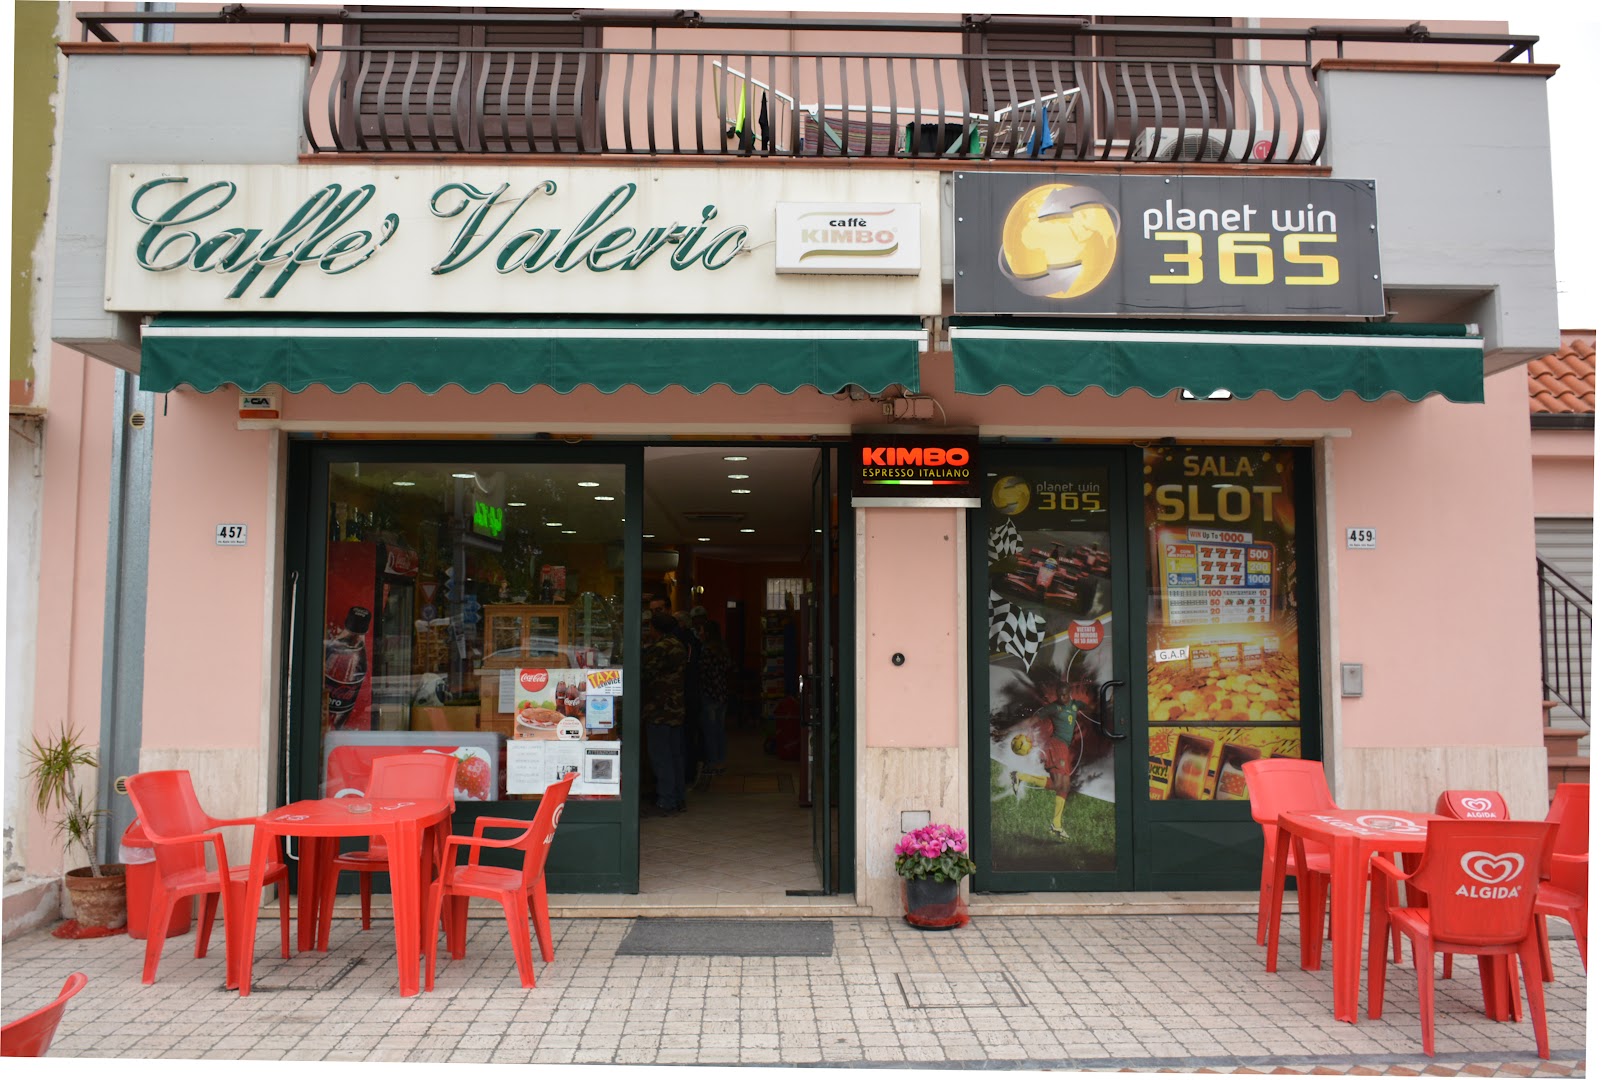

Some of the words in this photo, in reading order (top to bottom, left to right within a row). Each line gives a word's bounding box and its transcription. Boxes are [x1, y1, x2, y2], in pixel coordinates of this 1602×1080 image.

[829, 217, 868, 229] caffè
[1143, 199, 1257, 240] planet
[1271, 203, 1337, 233] win
[430, 180, 750, 275] Valerio
[800, 228, 895, 246] KIMBO
[1149, 232, 1341, 286] 365
[862, 447, 970, 467] KIMBO
[1183, 455, 1254, 478] SALA
[862, 468, 914, 478] ESPRESSO
[919, 468, 970, 478] ITALIANO
[1036, 481, 1074, 495] planet
[1078, 482, 1100, 492] win
[1038, 492, 1101, 511] 365
[1155, 483, 1283, 523] SLOT
[219, 526, 243, 539] 457
[1202, 532, 1210, 540] Up
[1219, 533, 1245, 543] 1000
[1350, 530, 1373, 542] 459
[1167, 544, 1177, 557] 2
[1200, 547, 1213, 559] 7
[1215, 547, 1228, 559] 7
[1230, 548, 1242, 560] 7
[1249, 549, 1269, 559] 500
[1201, 561, 1214, 572] 7
[1215, 561, 1228, 572] 7
[1230, 561, 1242, 573] 7
[1250, 562, 1269, 571] 200
[1169, 573, 1178, 585] 3
[1201, 574, 1214, 585] 7
[1216, 574, 1228, 585] 7
[1230, 574, 1243, 585] 7
[1248, 574, 1271, 584] 1000
[1207, 589, 1222, 597] 100
[1210, 607, 1220, 615] 20
[520, 672, 548, 683] Coca-Cola
[587, 670, 620, 689] TAXI
[1466, 811, 1496, 819] ALGIDA
[1455, 884, 1520, 900] ALGIDA
